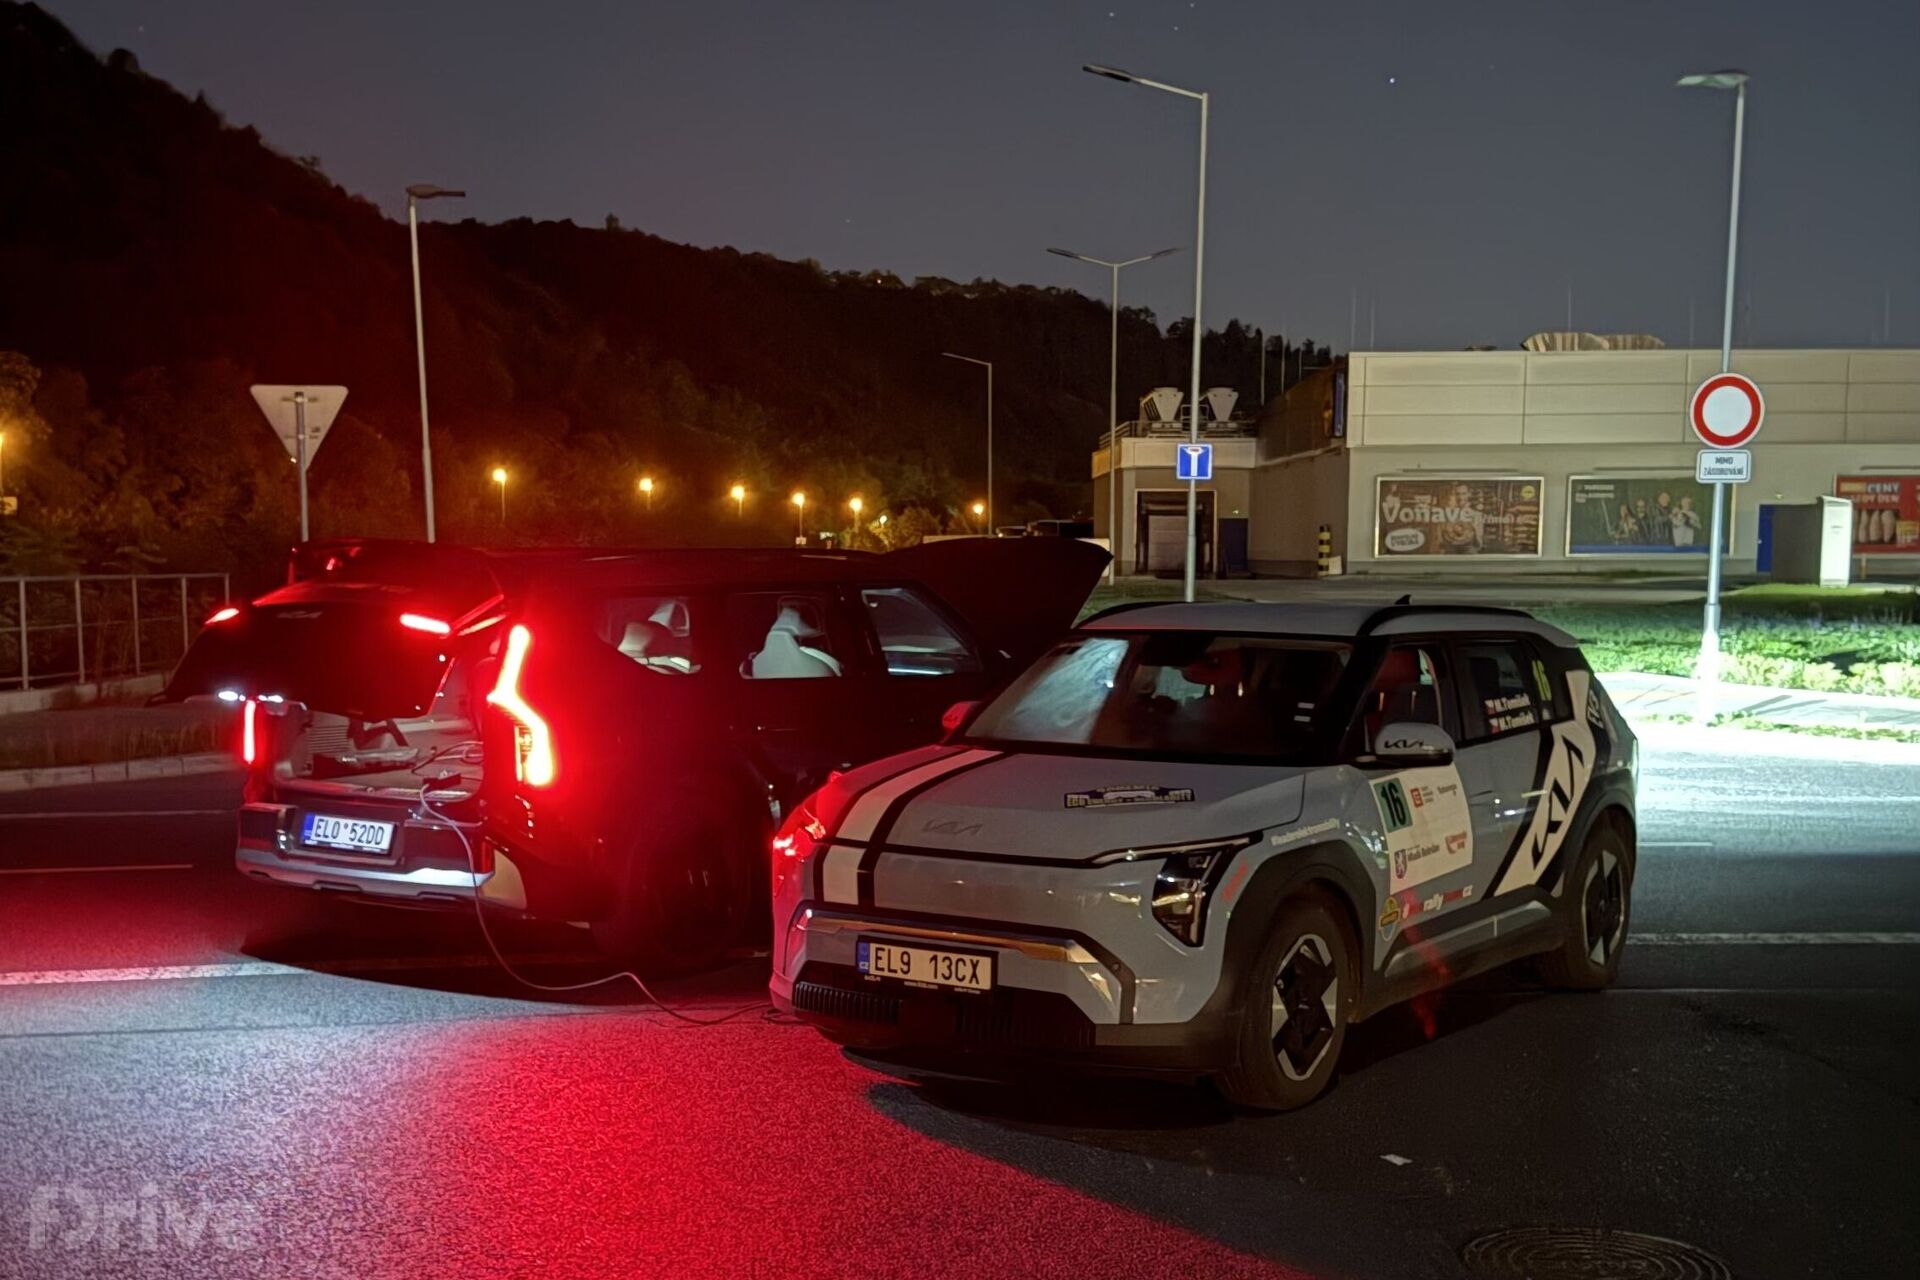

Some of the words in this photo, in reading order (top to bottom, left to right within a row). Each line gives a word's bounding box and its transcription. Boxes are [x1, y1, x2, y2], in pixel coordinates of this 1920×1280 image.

[1381, 782, 1407, 827] 16
[874, 946, 912, 975] EL9
[929, 953, 980, 985] 13CX
